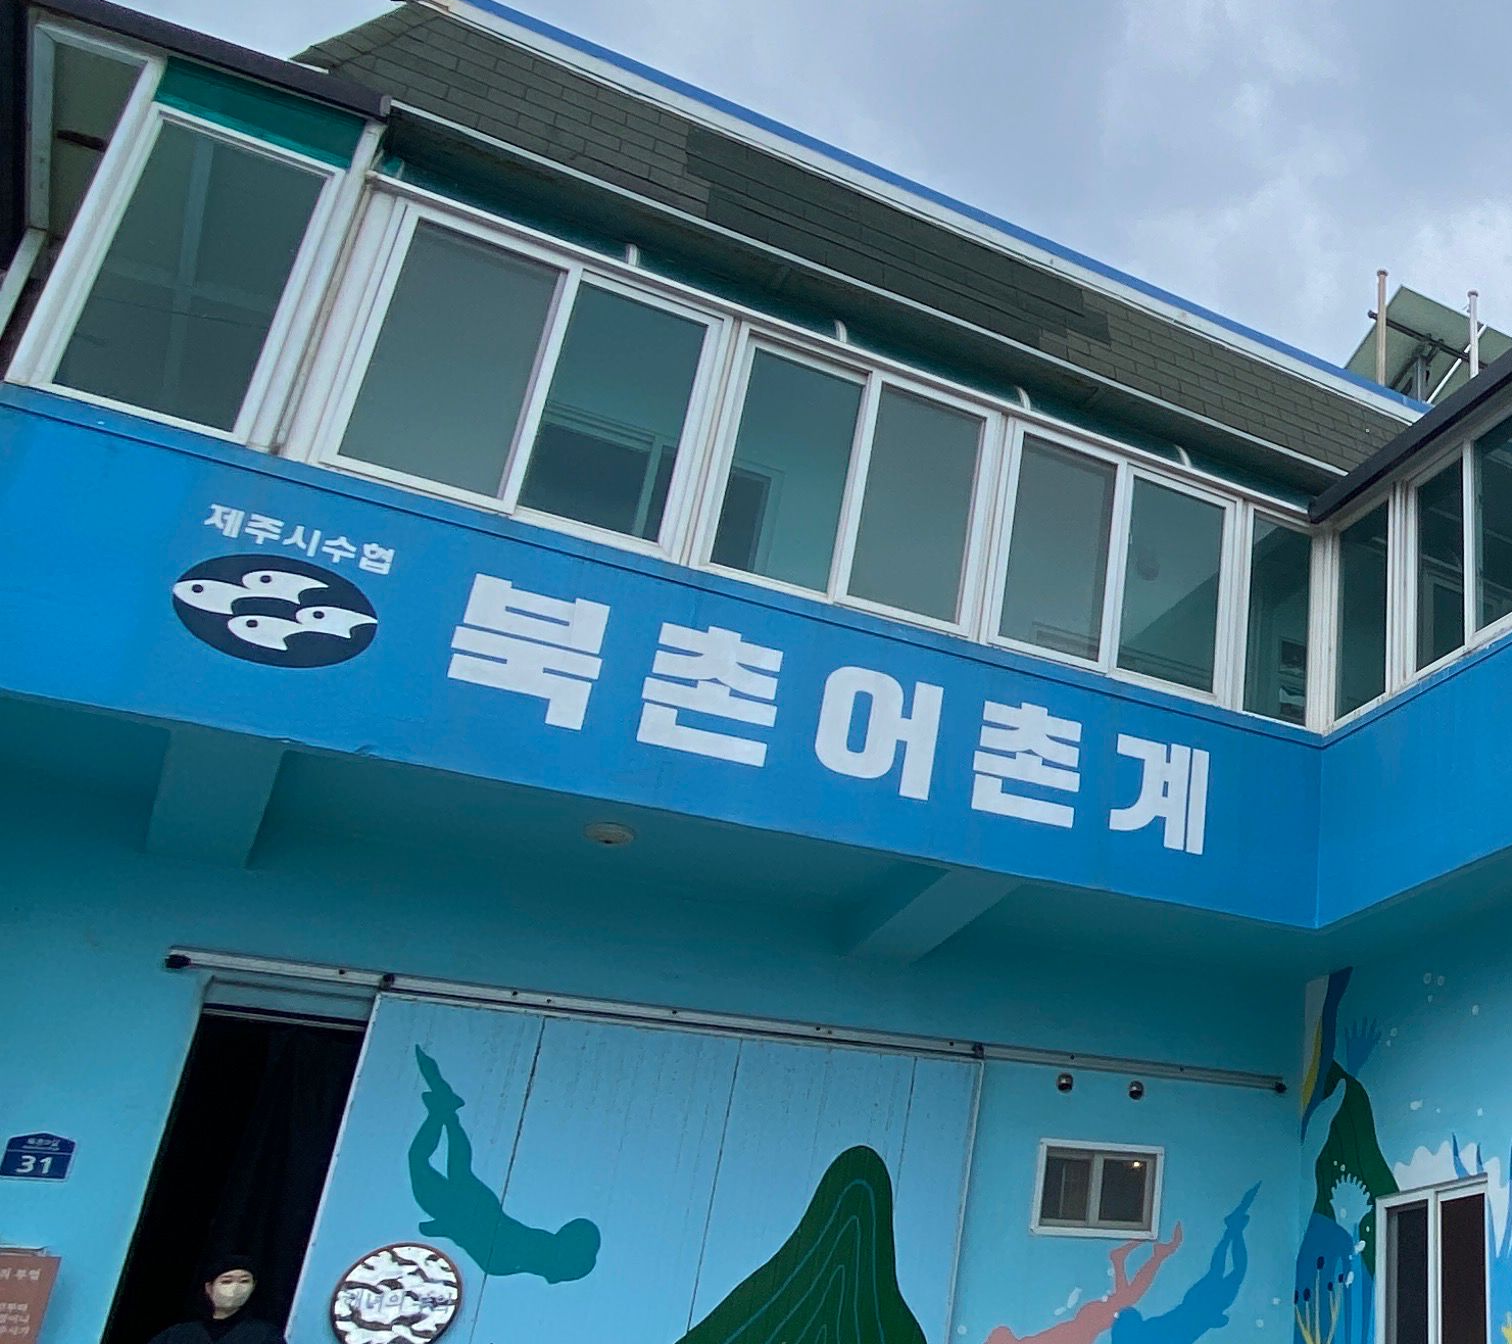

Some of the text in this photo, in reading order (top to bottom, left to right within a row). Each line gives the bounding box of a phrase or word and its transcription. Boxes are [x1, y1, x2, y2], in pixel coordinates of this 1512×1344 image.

[203, 502, 395, 575] 제주시수협
[447, 572, 1210, 855] 북촌어촌계
[15, 1154, 54, 1175] 31
